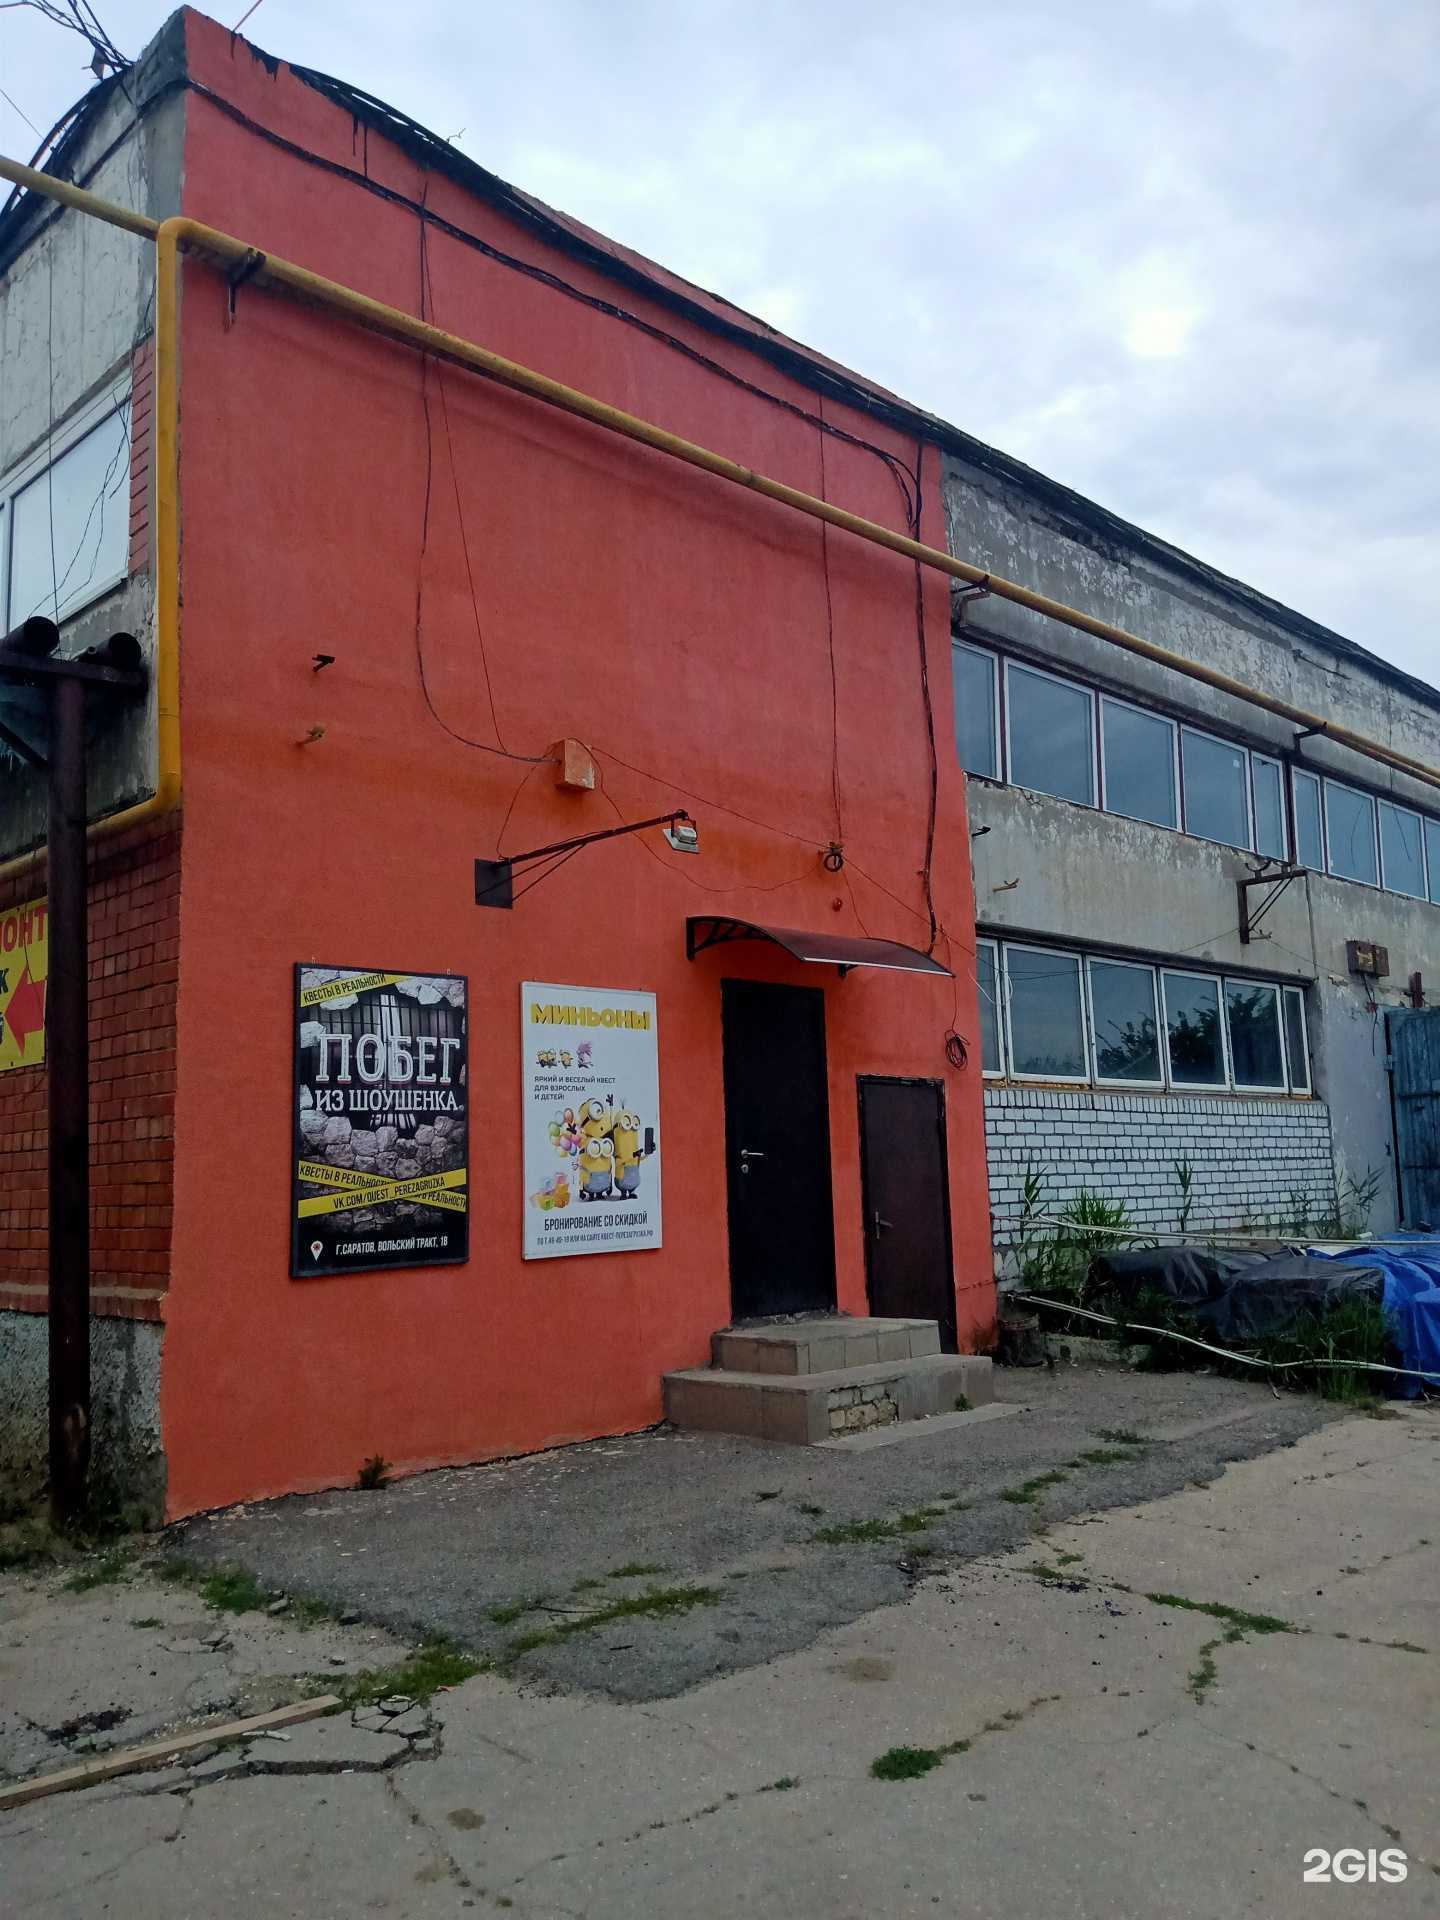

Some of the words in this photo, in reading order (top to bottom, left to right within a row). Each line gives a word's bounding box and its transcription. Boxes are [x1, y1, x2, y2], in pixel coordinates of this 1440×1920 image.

[0, 904, 48, 953] ОНТ
[303, 985, 335, 1003] КВЕСТЫ
[335, 984, 341, 995] В
[342, 973, 385, 993] РЕАЛЬНОСТИ
[530, 1003, 651, 1031] МИНЬОНЫ
[315, 1033, 461, 1083] ПОБЕГ
[534, 1075, 558, 1083] ЯРКИЙ
[566, 1076, 595, 1084] ВЕСЕЛЫЙ
[315, 1089, 344, 1112] ИЗ
[348, 1089, 459, 1112] ШОУШЕНКА
[299, 1165, 334, 1180] КВЕСТЫ
[334, 1172, 341, 1182] В
[544, 1216, 603, 1231] БРОНИРОВАНИЕ
[604, 1214, 614, 1227] СО
[615, 1211, 648, 1226] СКИДКОЙ
[377, 1237, 415, 1252] ВОЛЬСКИЙ
[440, 1236, 448, 1247] 18
